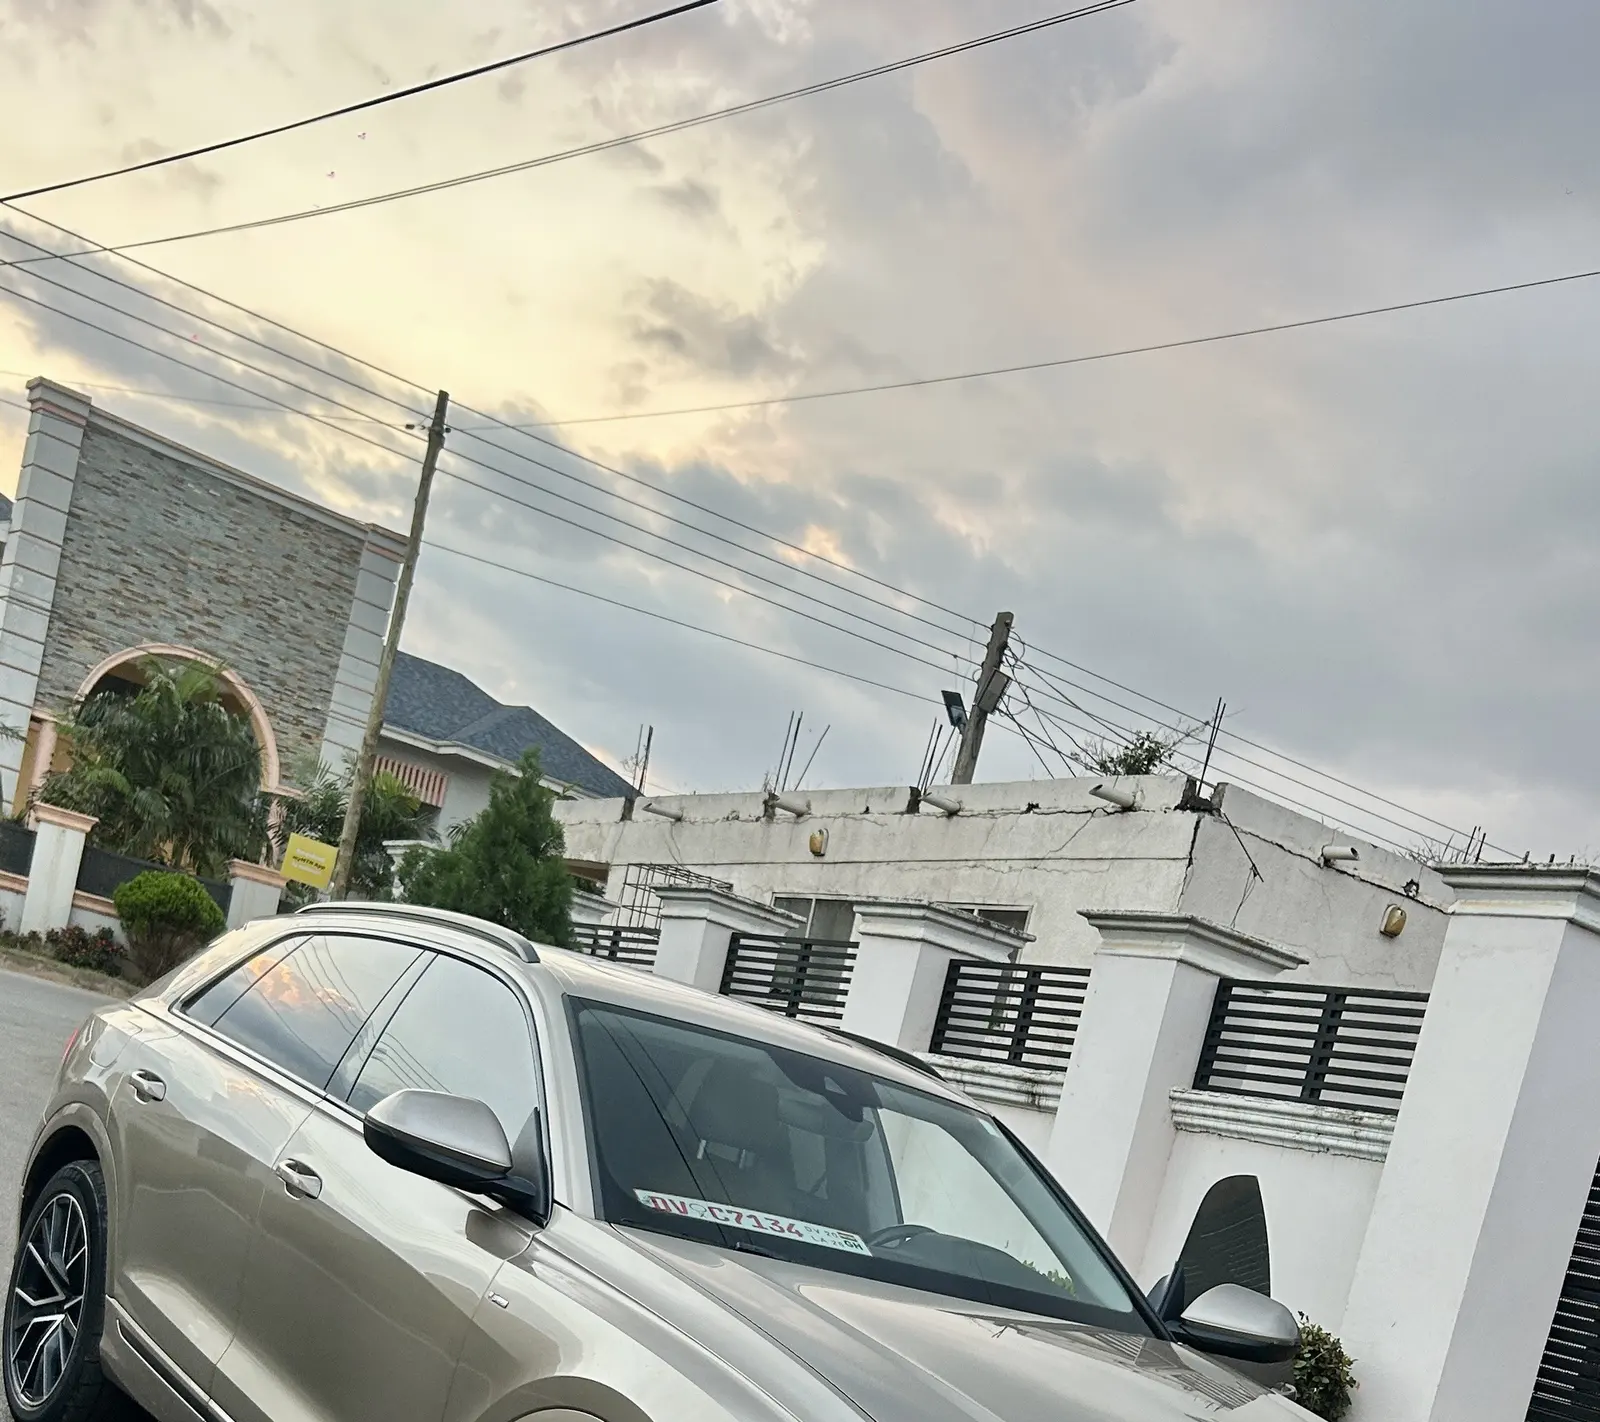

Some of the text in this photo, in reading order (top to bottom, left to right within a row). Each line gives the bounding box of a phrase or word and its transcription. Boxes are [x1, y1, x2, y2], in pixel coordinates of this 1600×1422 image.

[649, 1195, 804, 1238] DV C7134
[844, 1240, 864, 1251] GH
